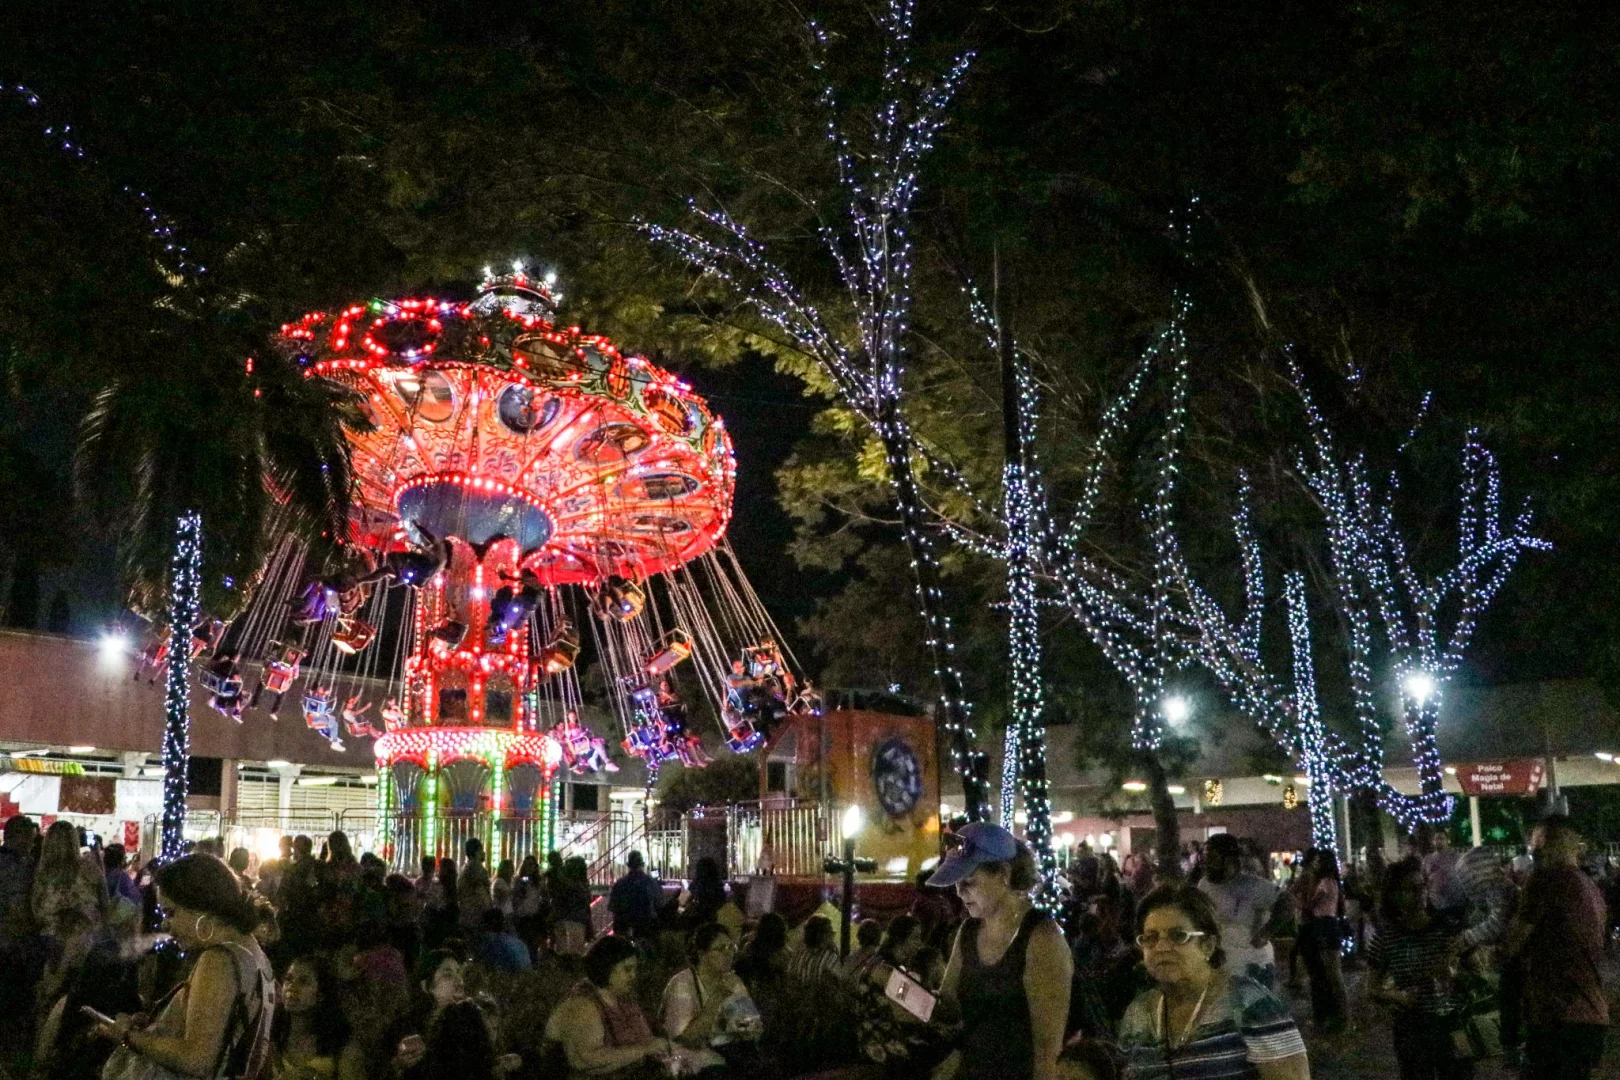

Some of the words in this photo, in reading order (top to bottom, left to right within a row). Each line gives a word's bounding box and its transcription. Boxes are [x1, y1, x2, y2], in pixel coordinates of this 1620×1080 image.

[1477, 764, 1503, 772] Palco
[1471, 773, 1498, 783] Magia
[1481, 782, 1504, 790] Natal
